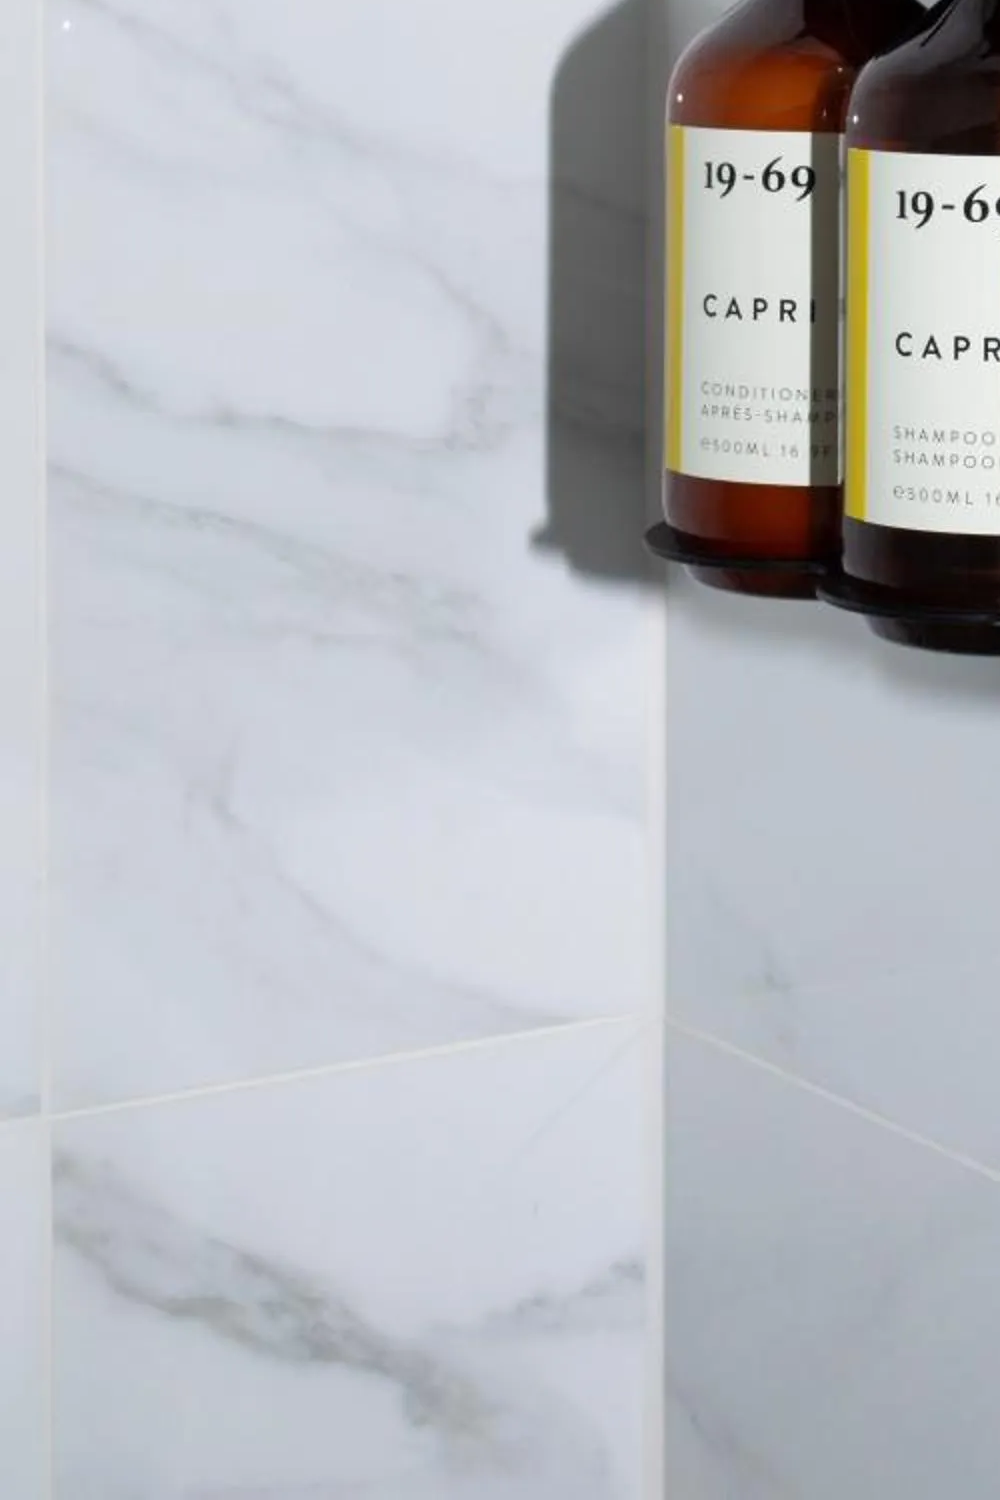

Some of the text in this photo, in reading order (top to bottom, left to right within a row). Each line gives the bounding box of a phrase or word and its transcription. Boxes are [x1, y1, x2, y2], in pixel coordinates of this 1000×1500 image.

[704, 156, 817, 202] 19-69
[703, 294, 816, 323] CAPRI
[893, 425, 996, 446] SHAMPOO
